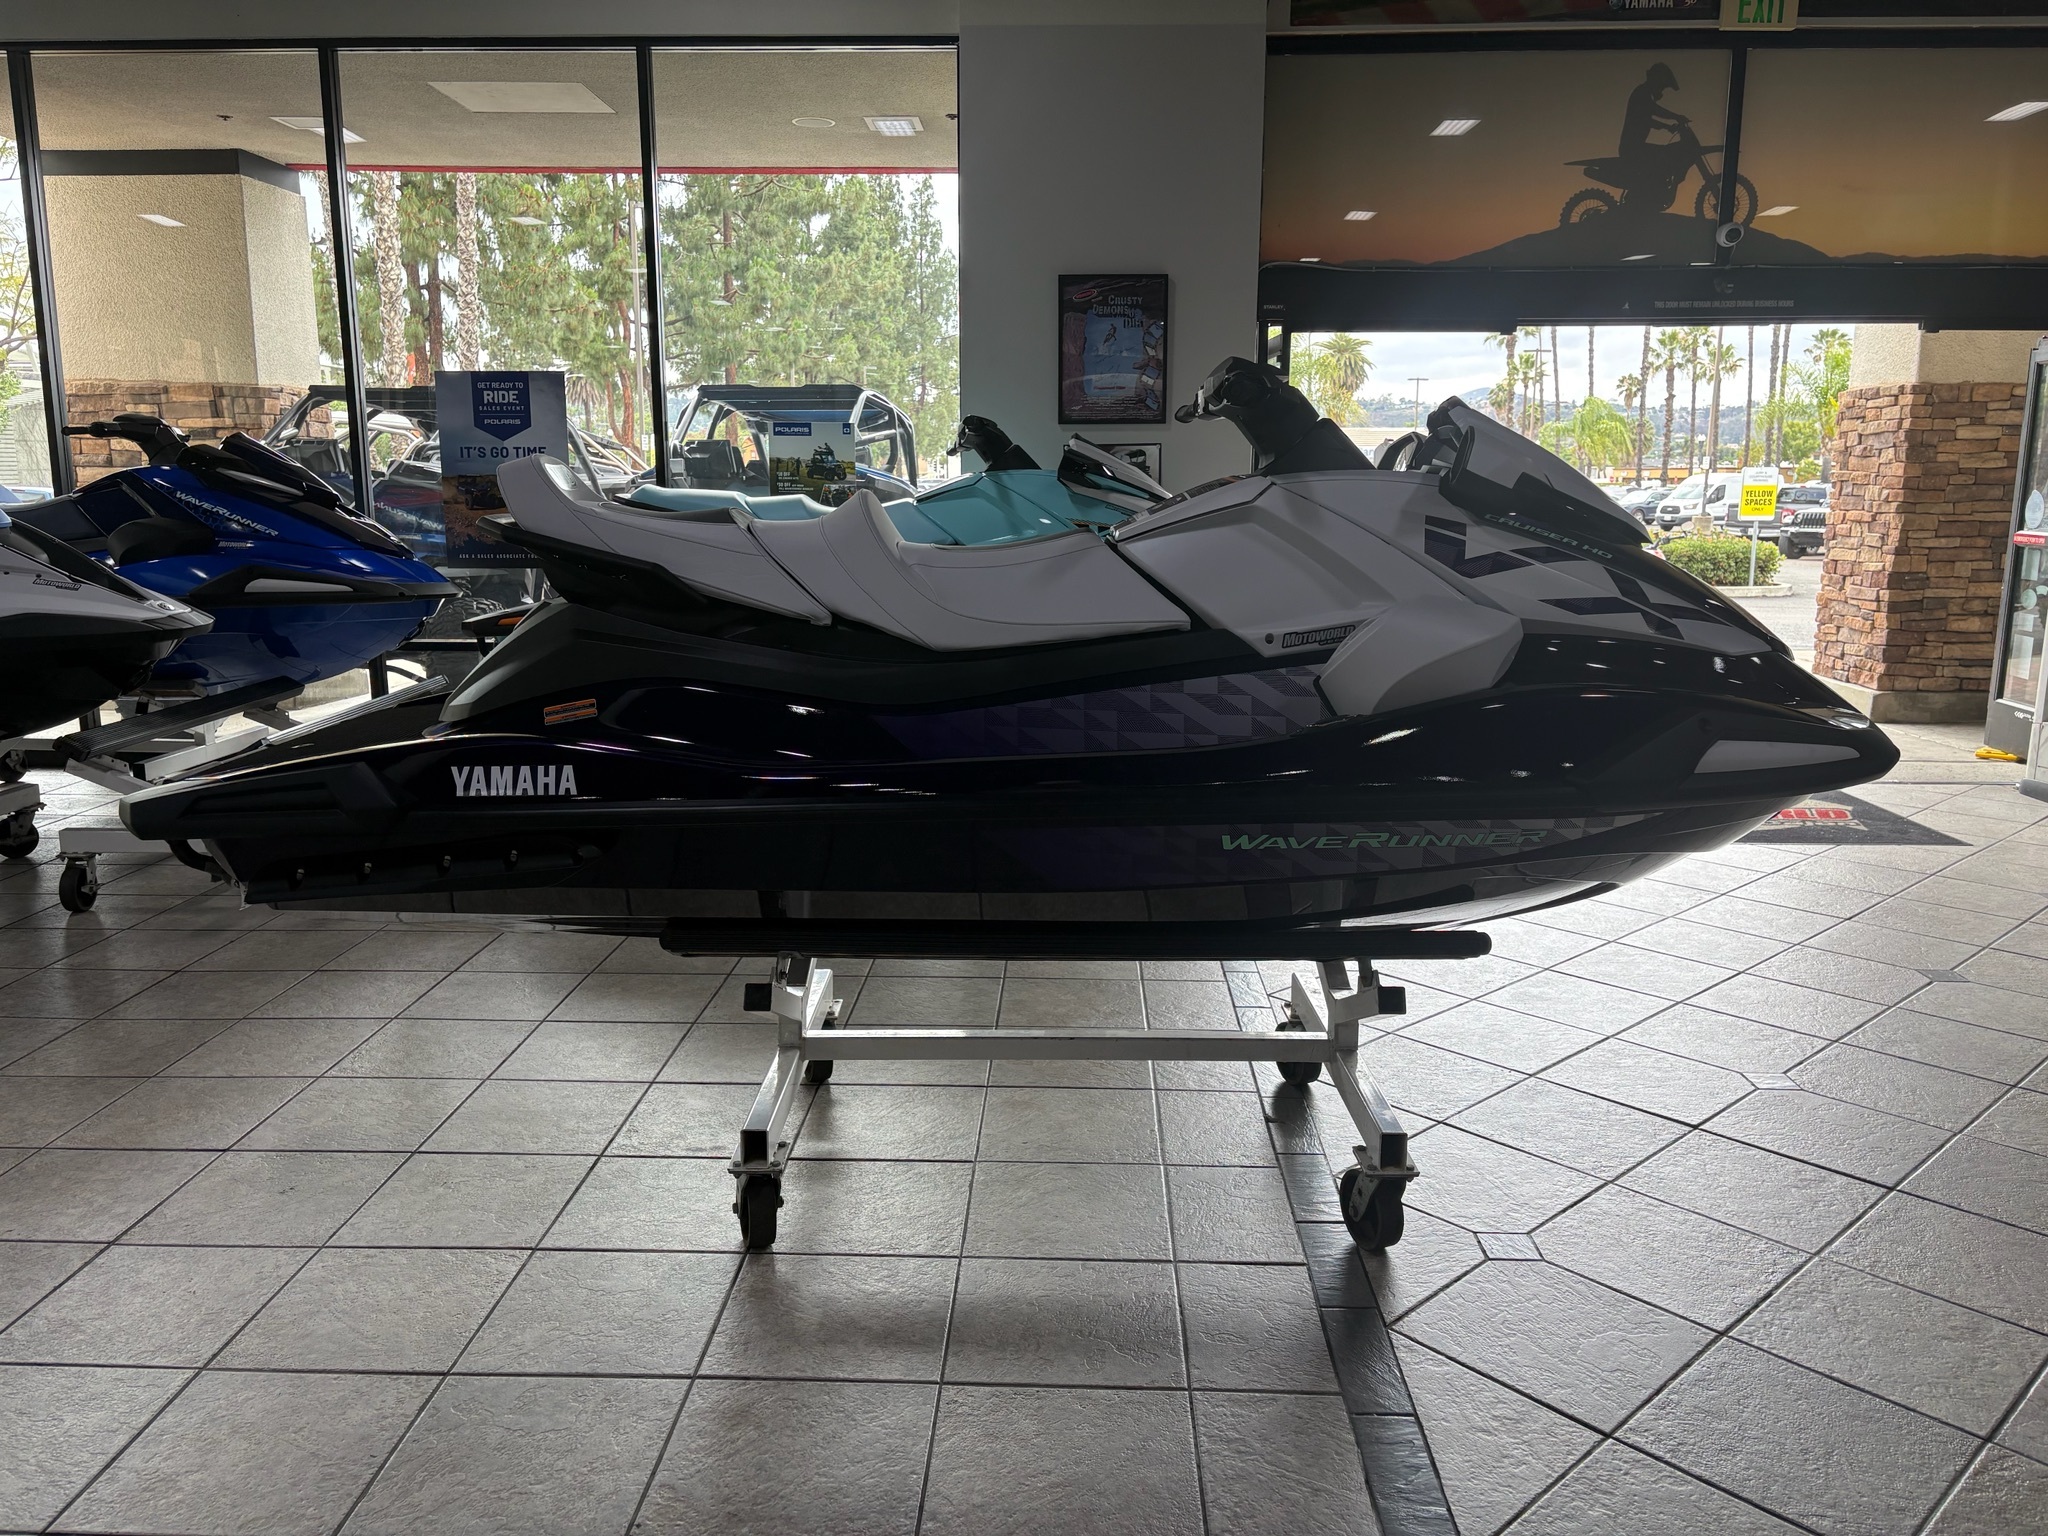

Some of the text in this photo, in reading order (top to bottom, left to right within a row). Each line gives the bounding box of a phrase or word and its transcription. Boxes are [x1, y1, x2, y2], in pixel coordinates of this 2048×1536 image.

[1625, 0, 1674, 8] YAMAHA
[1108, 295, 1143, 304] CRUSTY
[1712, 300, 1736, 308] UNLOCKED
[1092, 304, 1128, 315] DEMONS
[483, 390, 519, 404] RIDE
[460, 447, 486, 458] IT'S
[490, 447, 509, 458] GO
[175, 491, 279, 537] WAVERUNNER
[1484, 514, 1613, 559] CRUISER HD
[34, 579, 81, 589] MOTOWORLD
[1283, 626, 1355, 647] MOTOWORLD
[450, 765, 577, 797] YAMAHA
[1221, 830, 1548, 850] WAVERUNNER
